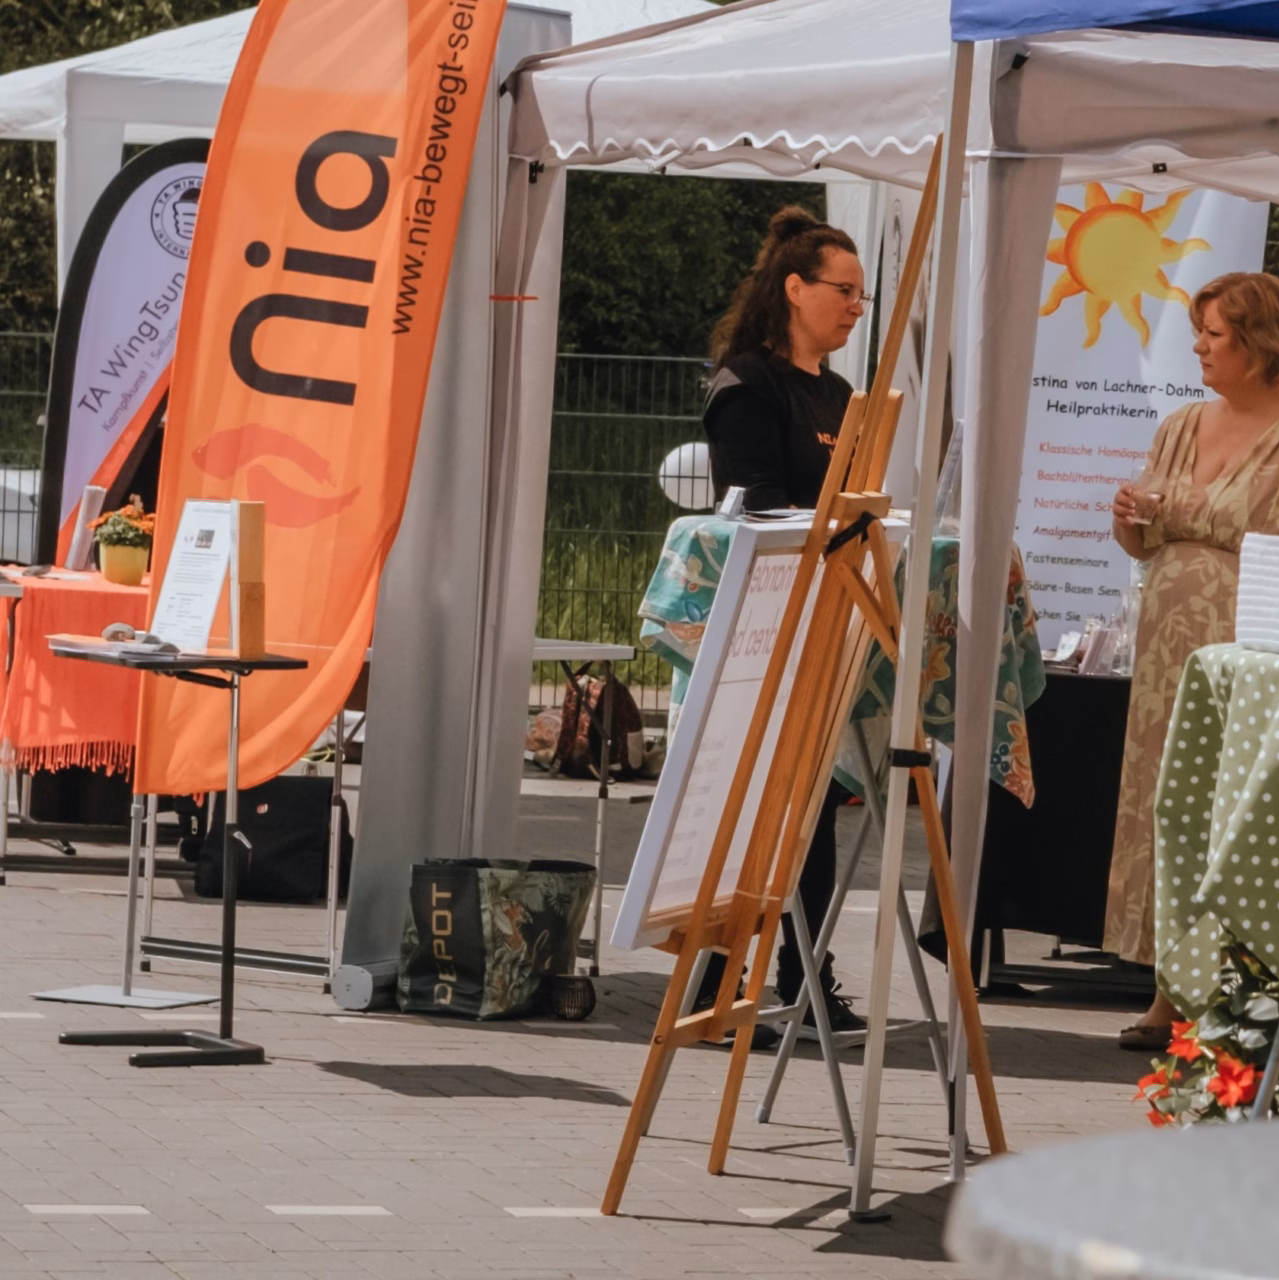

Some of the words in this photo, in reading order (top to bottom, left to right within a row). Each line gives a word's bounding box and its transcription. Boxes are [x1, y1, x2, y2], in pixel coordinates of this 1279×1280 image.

[229, 129, 399, 407] nia
[77, 386, 112, 414] TA
[100, 272, 186, 379] WingTsun
[1032, 375, 1068, 389] stina
[1075, 380, 1098, 391] von
[1103, 379, 1205, 399] Lachner-Dahm
[102, 370, 149, 433] Kampfkunst
[1046, 400, 1158, 419] Heilpraktikerin
[1039, 442, 1093, 456] Klassische
[1033, 497, 1090, 511] Natürliche
[1033, 526, 1114, 542] Amalgamentgif
[1025, 551, 1110, 568] Fastenseminare
[1065, 610, 1082, 621] Sie
[432, 882, 457, 1006] DEPOT
